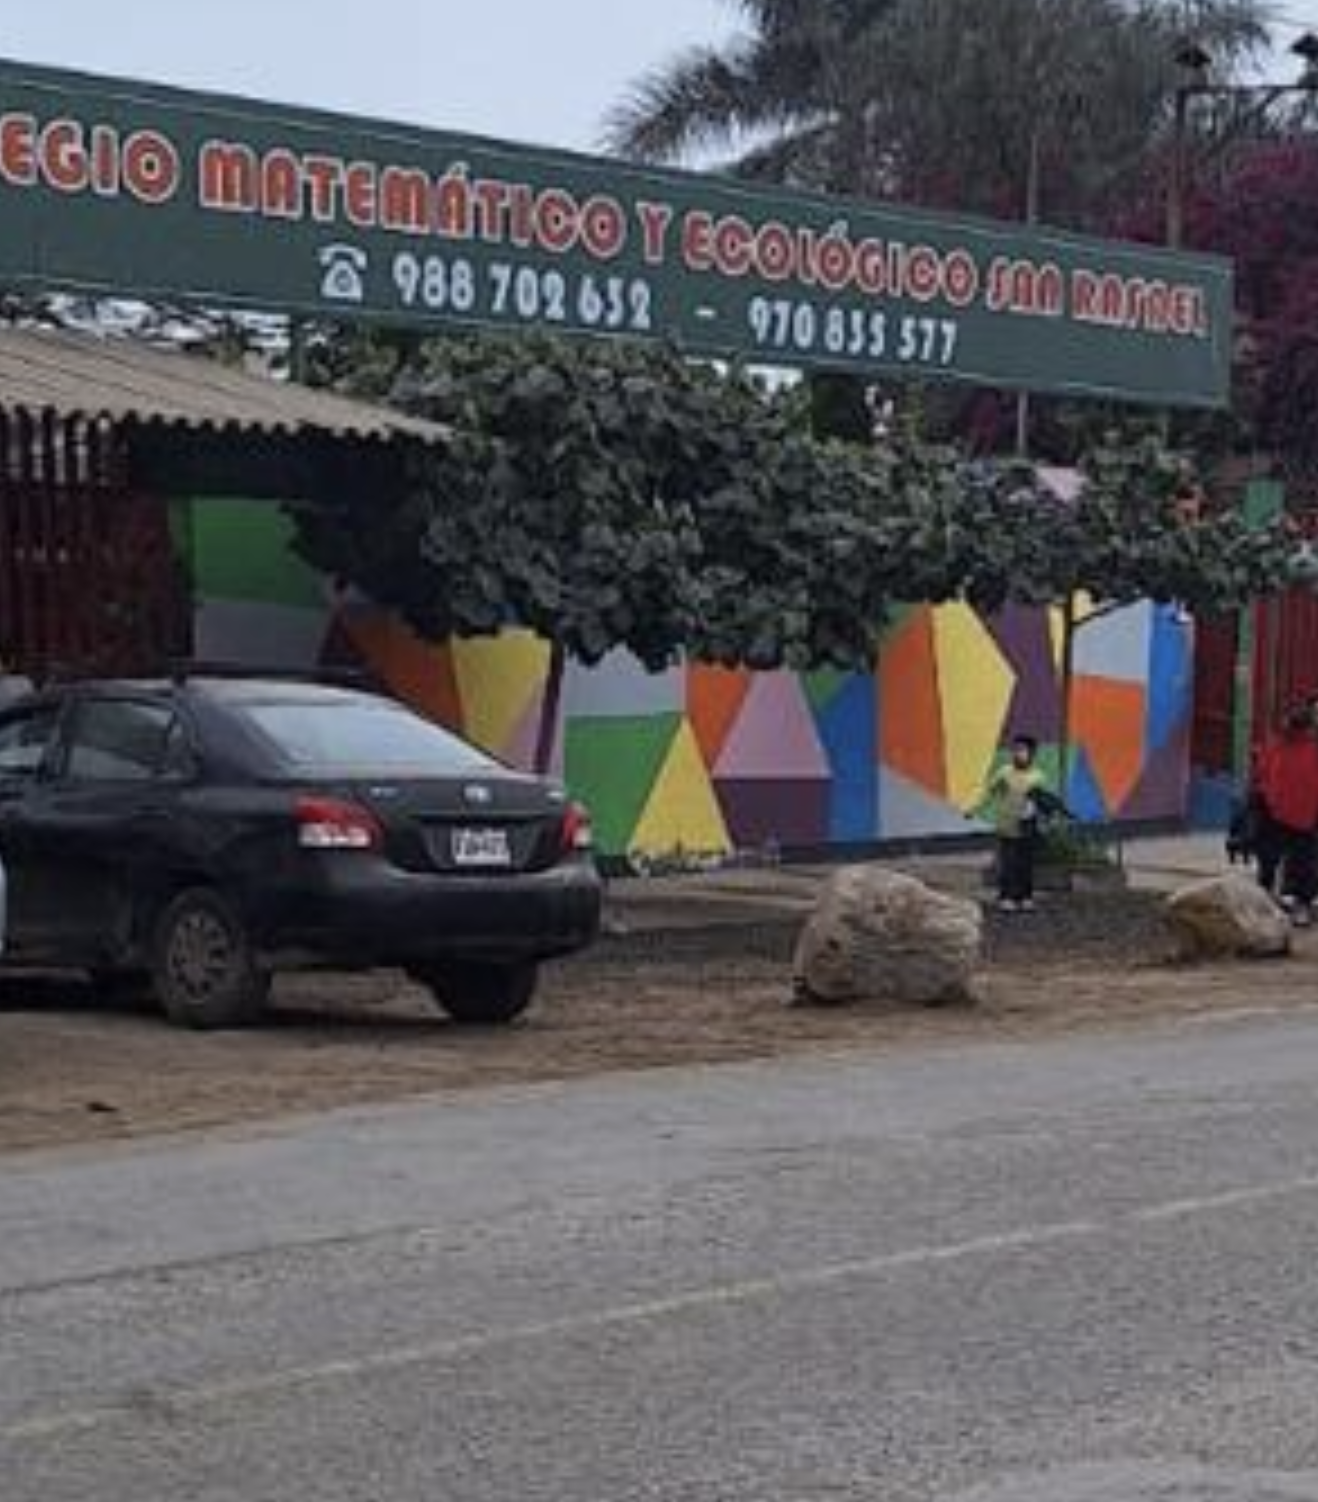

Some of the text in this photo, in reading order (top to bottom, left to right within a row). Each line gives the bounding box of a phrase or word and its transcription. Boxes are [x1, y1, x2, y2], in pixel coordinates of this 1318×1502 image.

[199, 139, 627, 258] MATEMÁTICO
[635, 202, 673, 264] Y
[684, 210, 978, 306] ECOLÓGICO
[986, 256, 1063, 316] SAN
[393, 254, 475, 311] 988
[490, 263, 565, 321] 702
[750, 297, 815, 348] 970
[899, 316, 957, 364] 577
